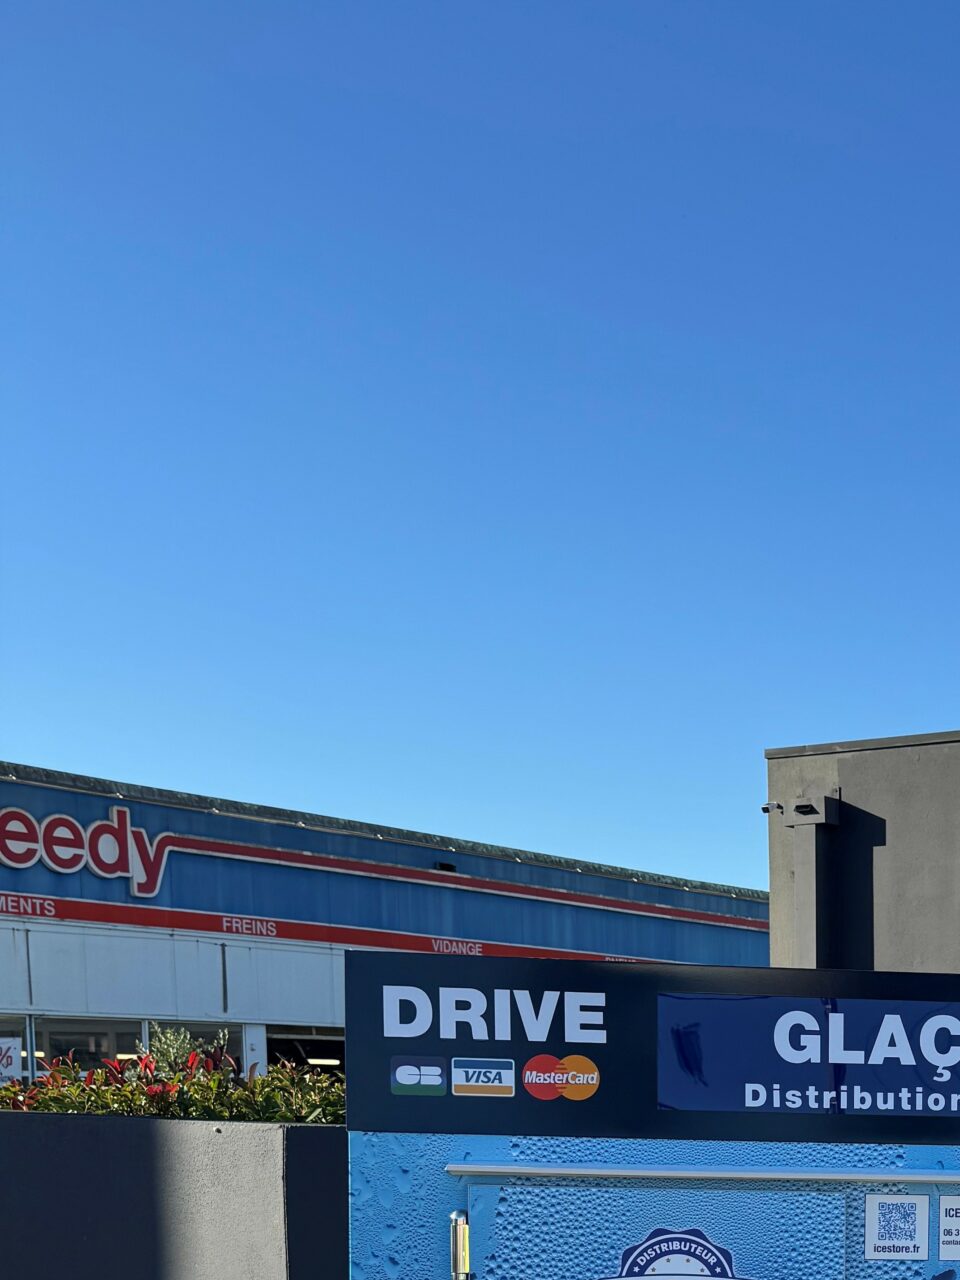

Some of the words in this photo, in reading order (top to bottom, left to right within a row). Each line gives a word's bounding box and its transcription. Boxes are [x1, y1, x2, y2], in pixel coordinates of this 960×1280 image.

[222, 916, 277, 936] FREINS
[431, 939, 482, 956] VIDANGE
[382, 985, 607, 1043] DRIVE
[461, 1069, 503, 1085] VISA
[524, 1069, 598, 1087] MasterCard
[943, 1229, 953, 1237] 06
[636, 1241, 717, 1266] DISTRIBUTEUR
[873, 1243, 921, 1254] icestore.fr
